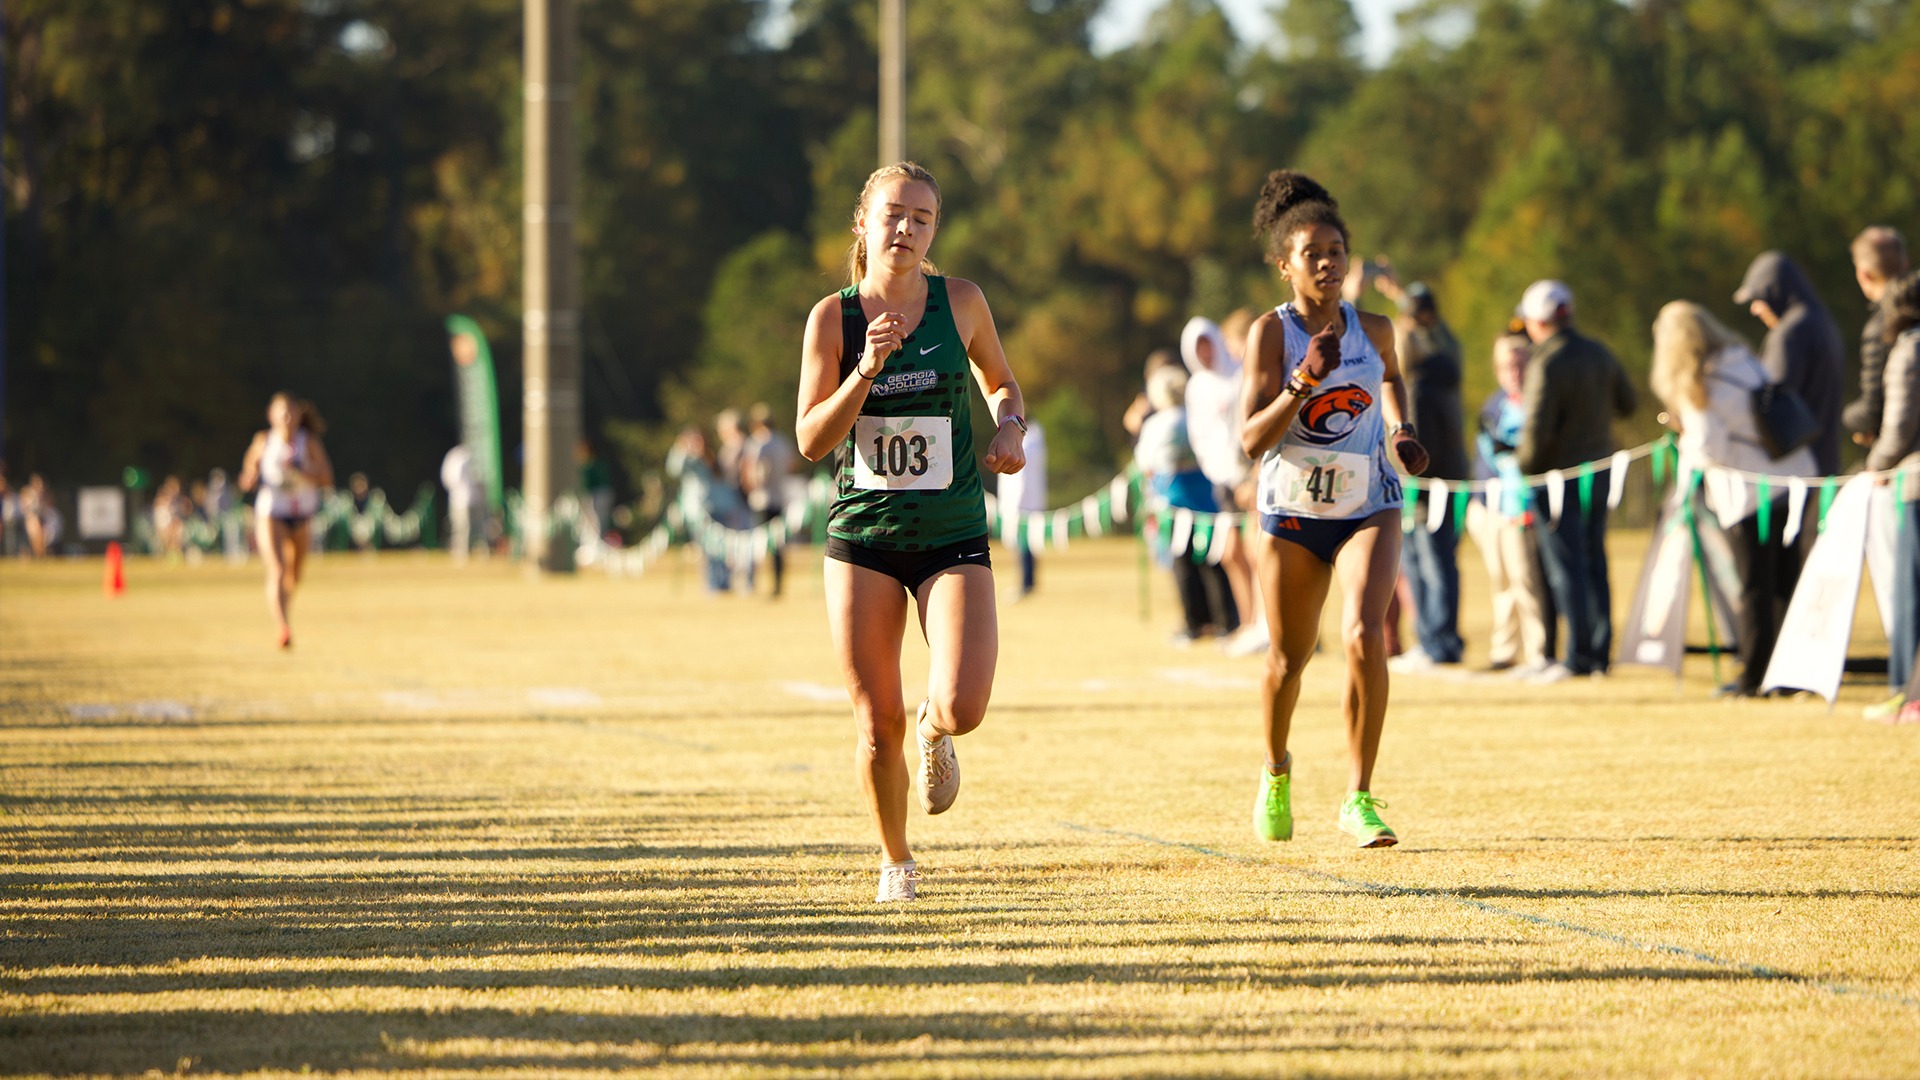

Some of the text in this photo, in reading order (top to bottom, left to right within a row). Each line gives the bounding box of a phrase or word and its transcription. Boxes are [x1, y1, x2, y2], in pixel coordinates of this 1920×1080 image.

[887, 370, 936, 383] GEORGIA
[888, 377, 937, 390] COLLEGE
[873, 435, 929, 476] 103
[1306, 465, 1336, 503] 41
